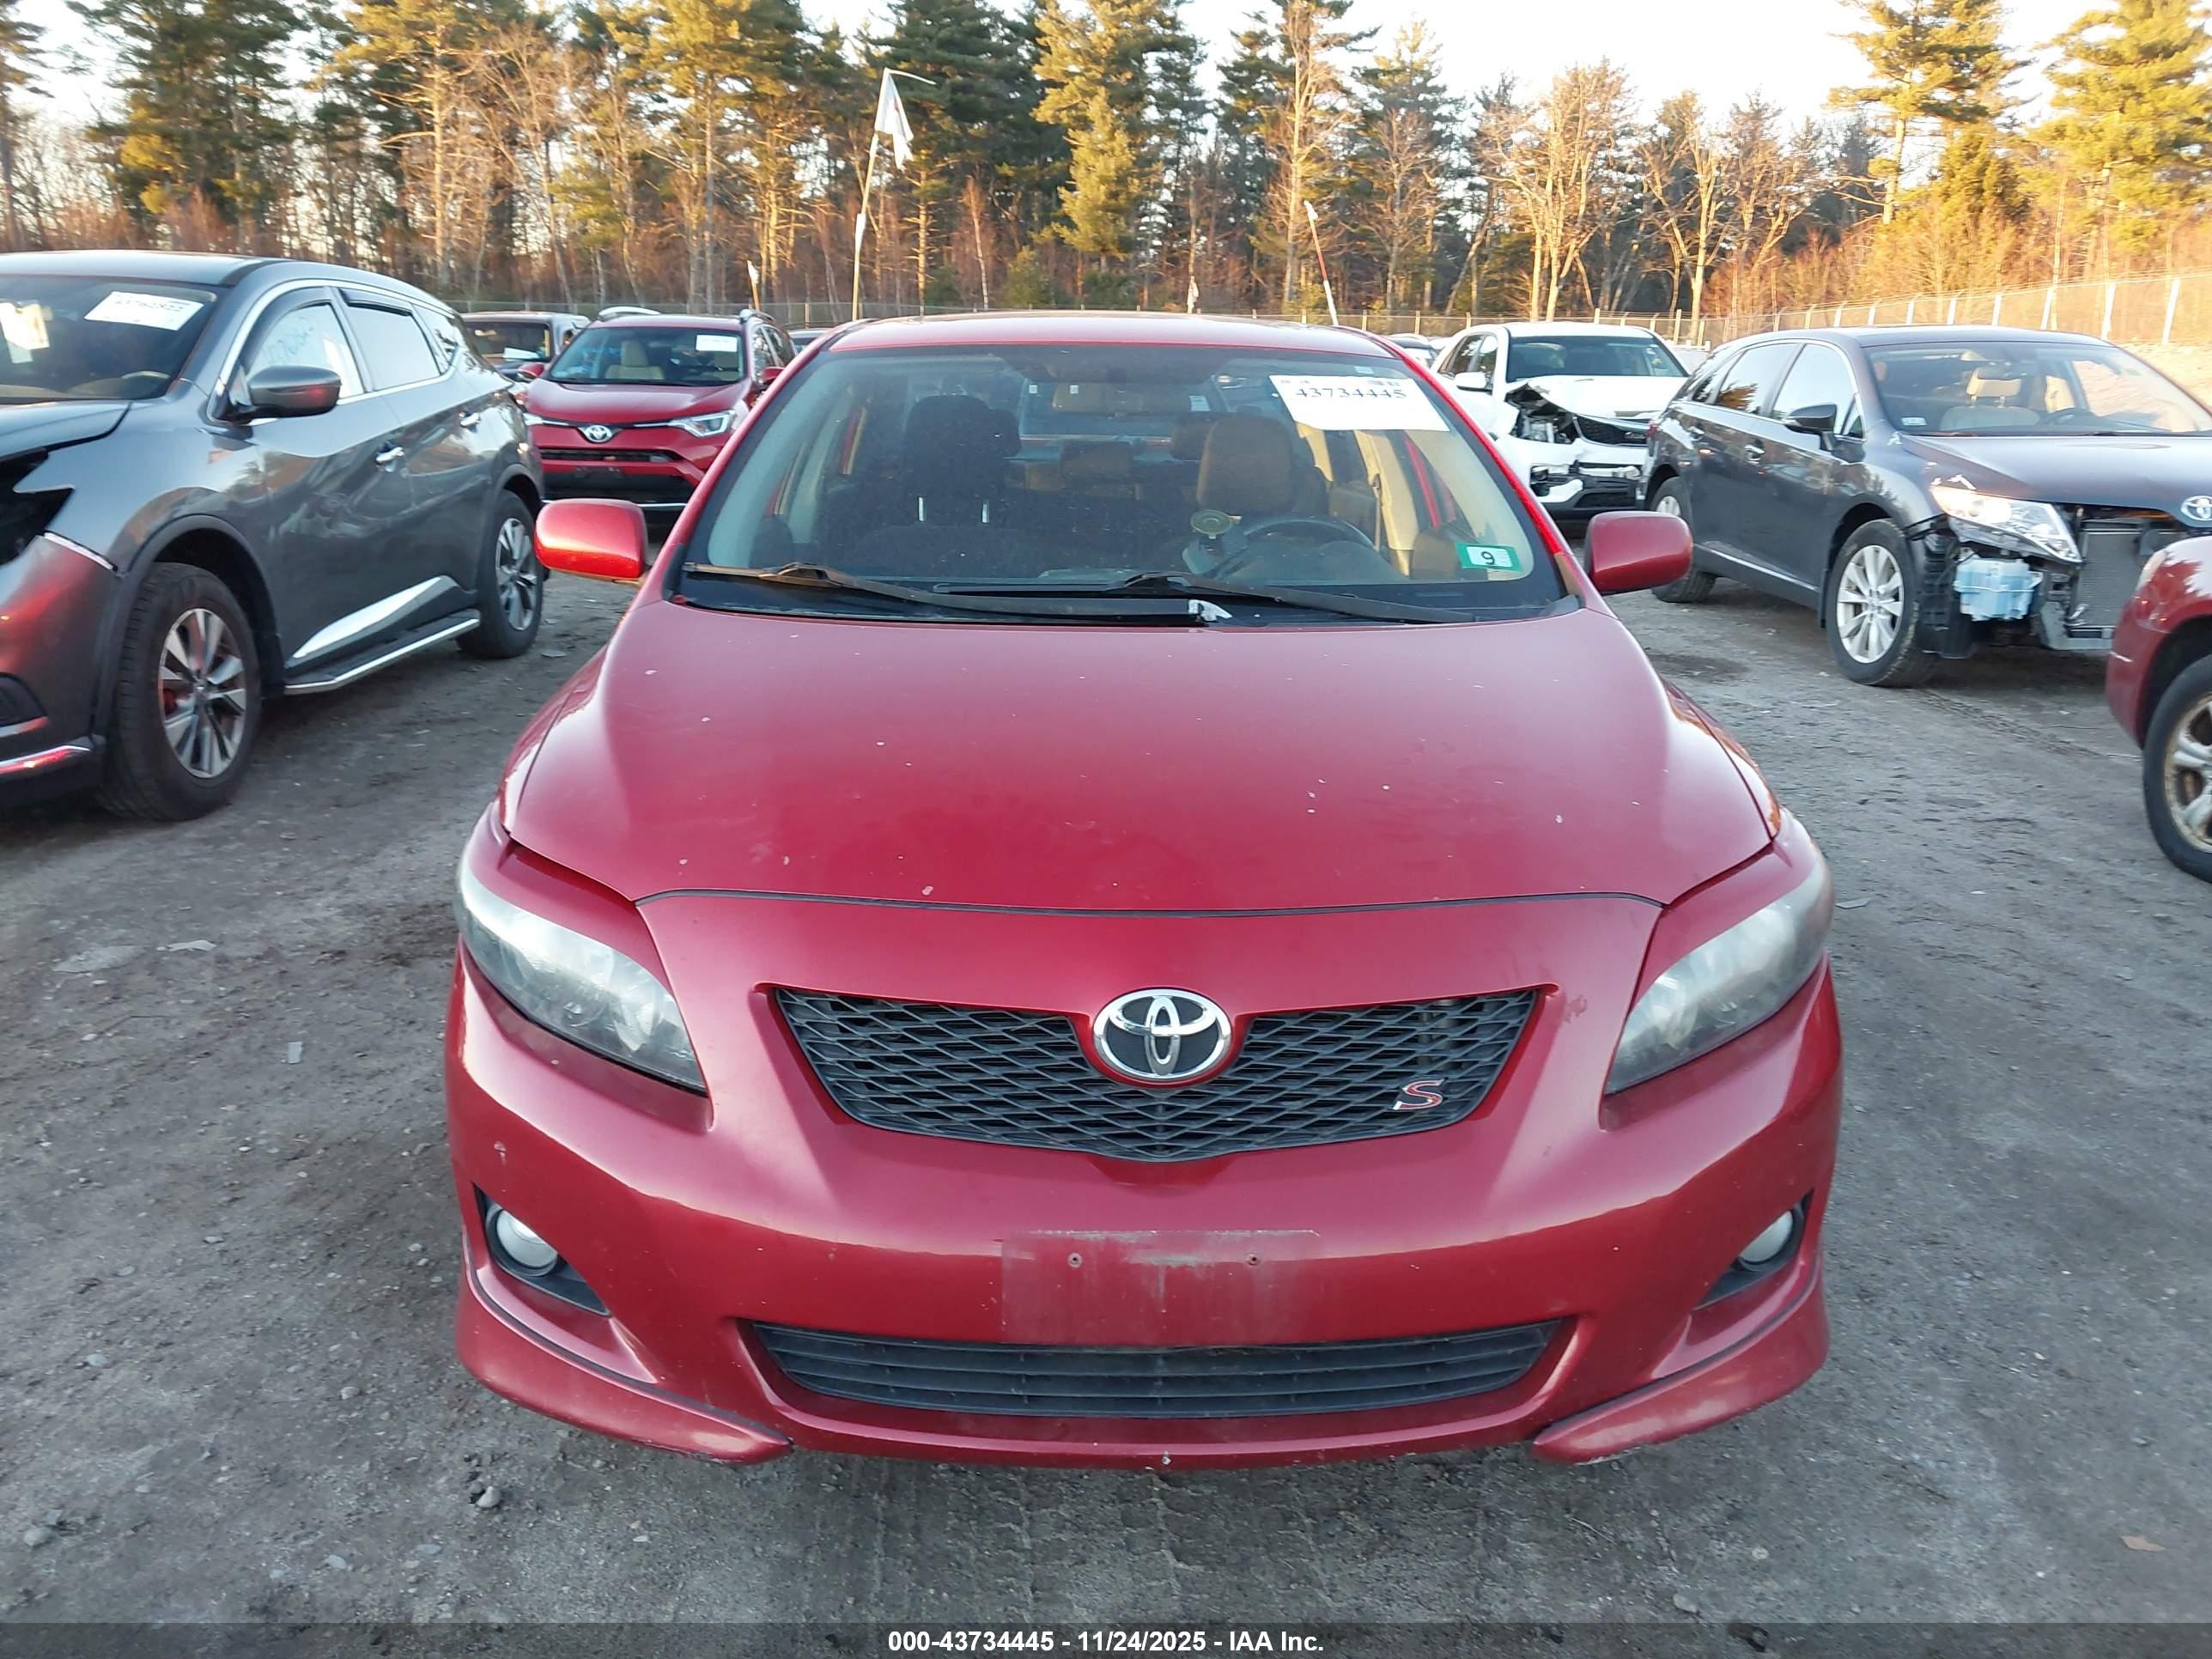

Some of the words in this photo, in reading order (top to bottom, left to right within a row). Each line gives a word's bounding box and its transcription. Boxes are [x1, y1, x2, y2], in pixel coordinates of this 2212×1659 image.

[1295, 387, 1407, 399] 43734445
[1480, 550, 1495, 565] 9
[1393, 1079, 1444, 1110] S
